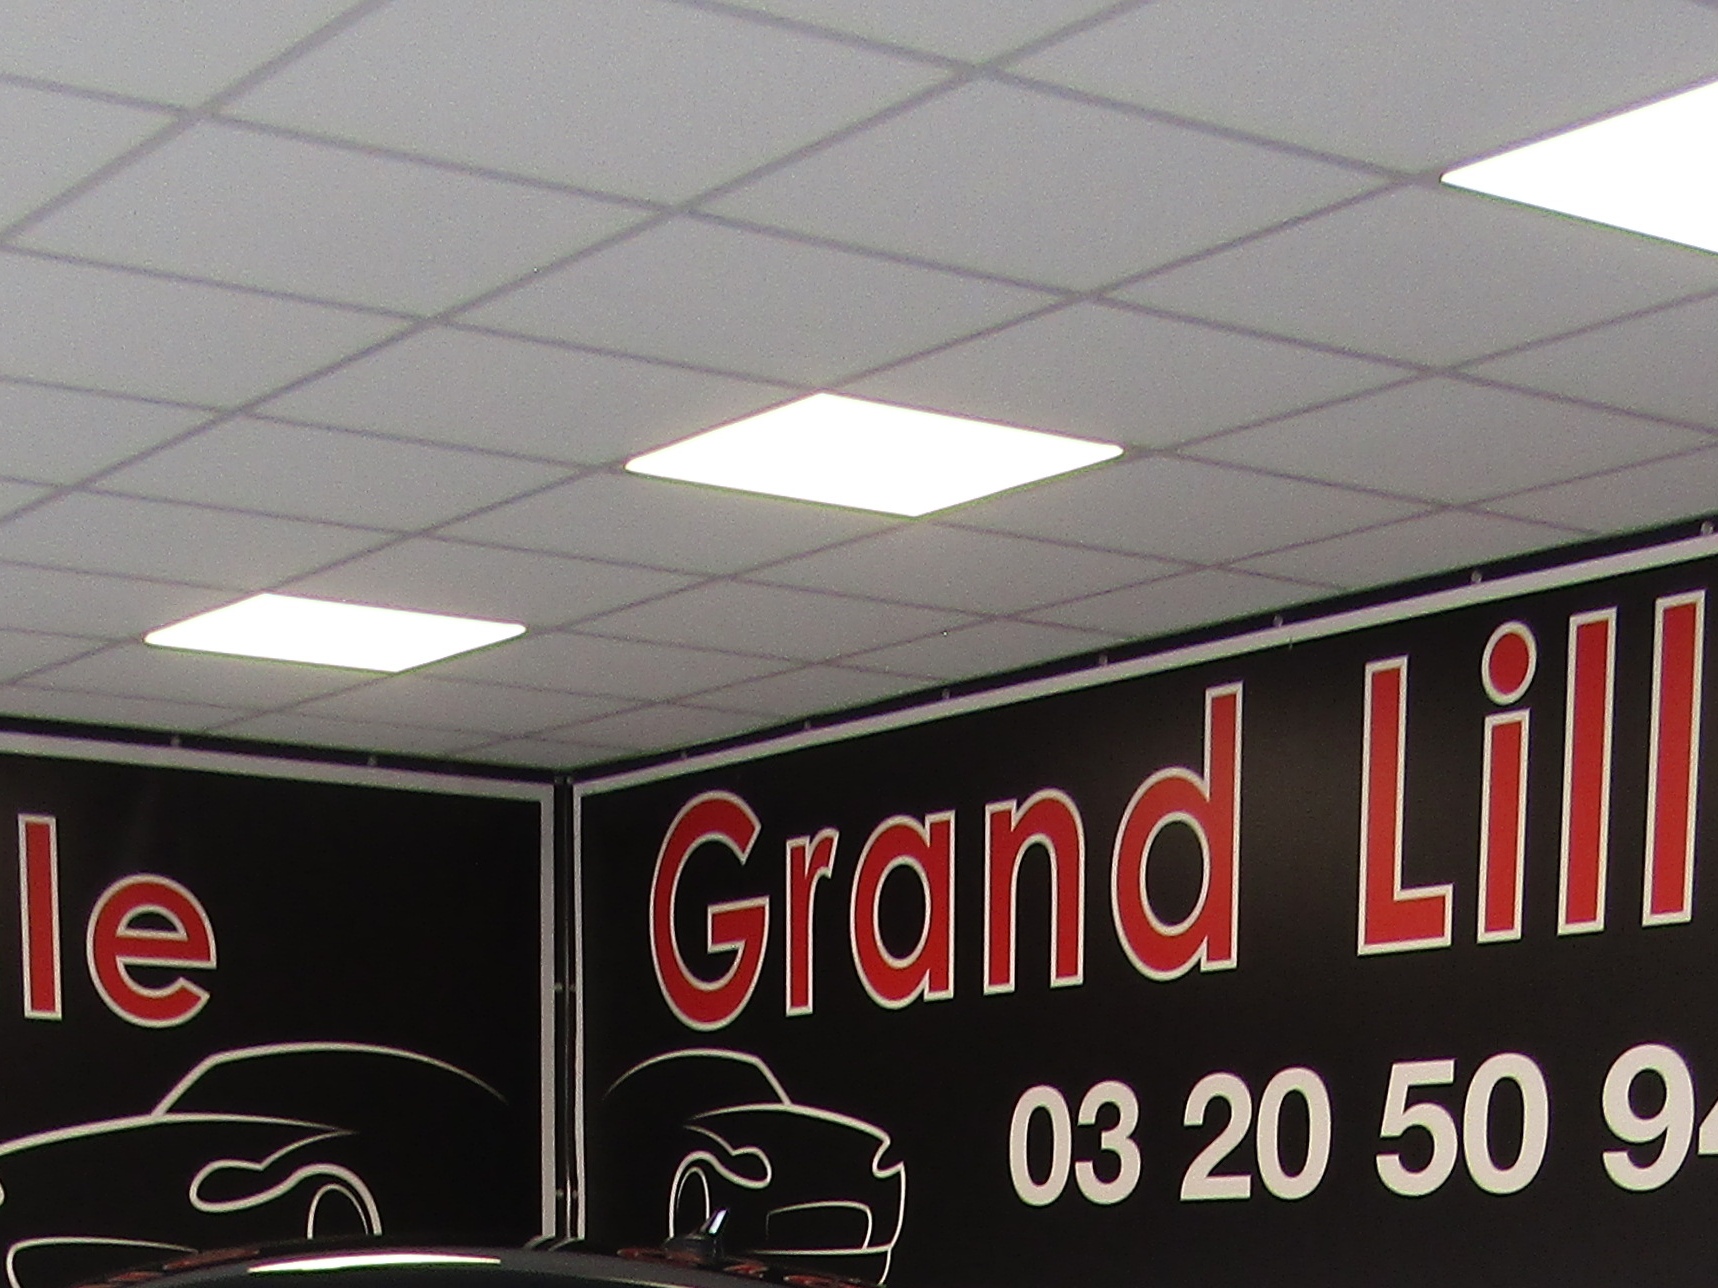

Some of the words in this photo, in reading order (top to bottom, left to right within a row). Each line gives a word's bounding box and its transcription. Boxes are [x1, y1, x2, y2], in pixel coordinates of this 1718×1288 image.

[649, 681, 1244, 1032] Grand
[1009, 1080, 1142, 1206] 03
[1180, 1066, 1332, 1201] 20
[1375, 1052, 1549, 1197] 50
